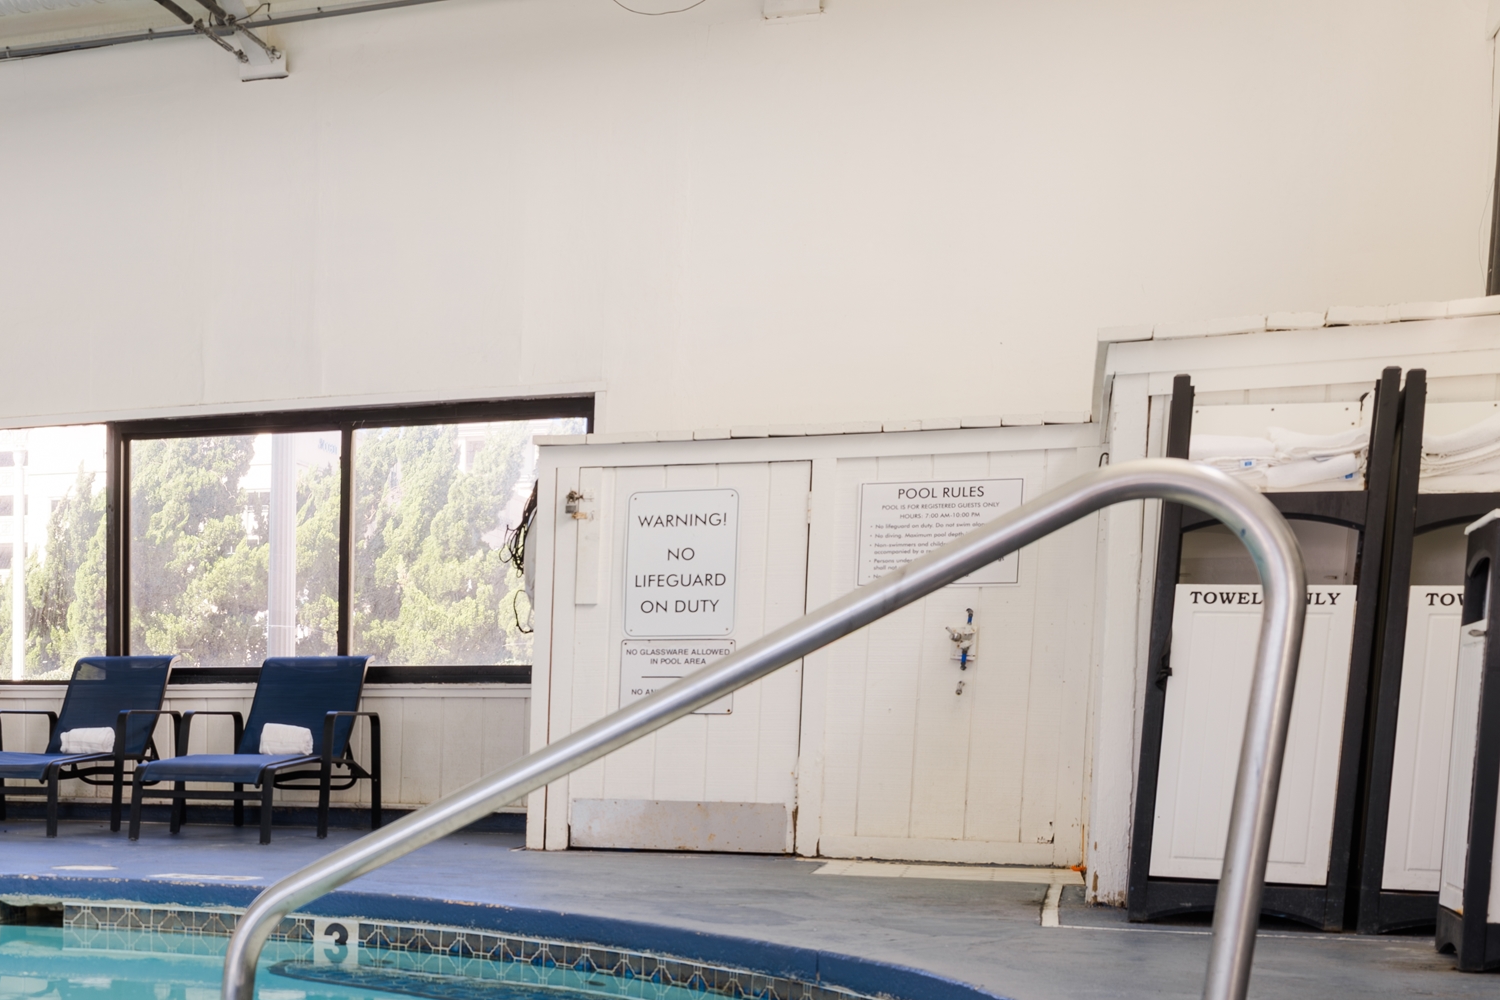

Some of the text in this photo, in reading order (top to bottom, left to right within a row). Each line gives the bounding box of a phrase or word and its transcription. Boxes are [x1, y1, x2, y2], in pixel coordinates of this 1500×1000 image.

[898, 486, 985, 499] POOL RULES
[638, 513, 727, 527] WARNING!
[667, 548, 695, 560] NO
[635, 573, 726, 587] LIFEGUARD
[1190, 592, 1263, 604] TOWEL
[640, 600, 719, 613] ON DUTY
